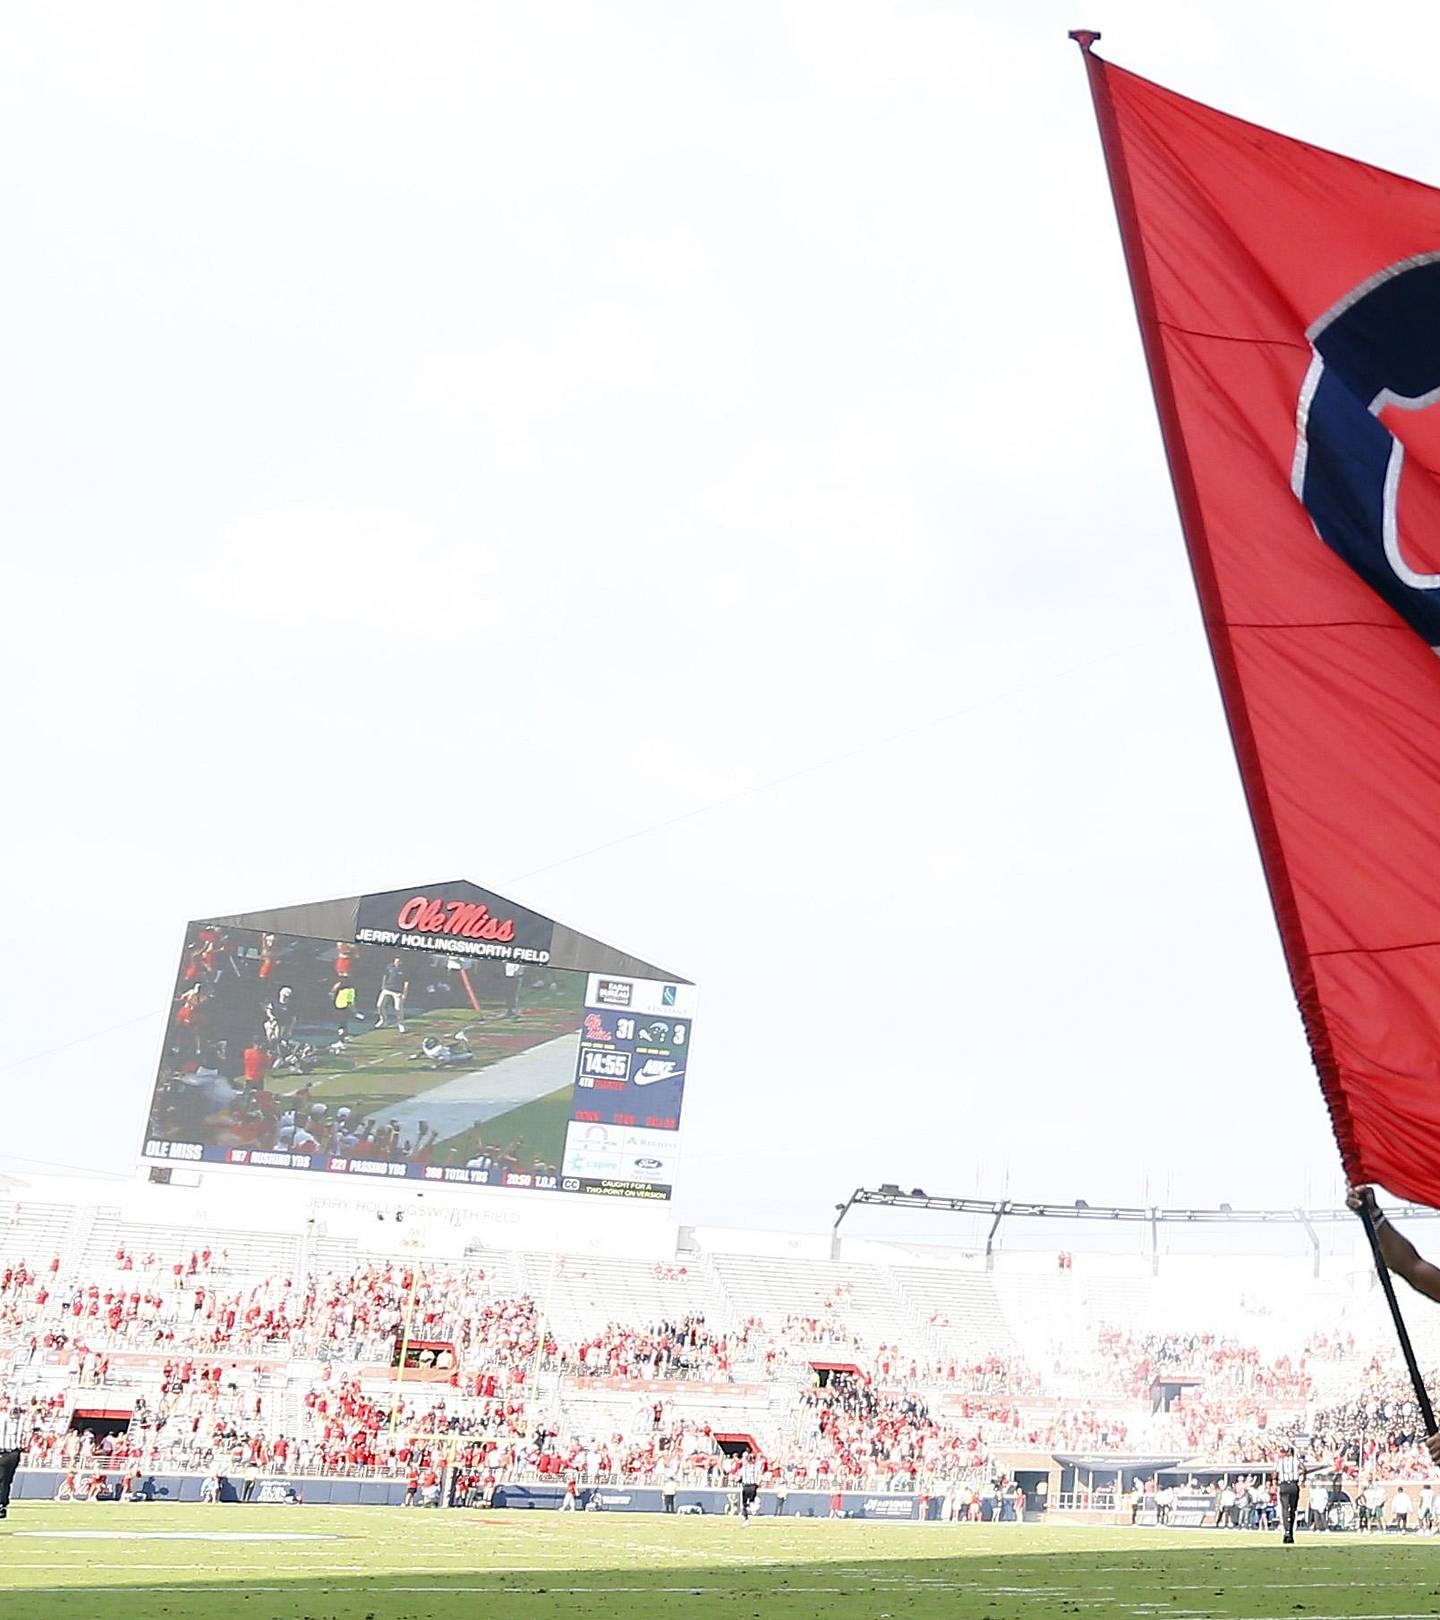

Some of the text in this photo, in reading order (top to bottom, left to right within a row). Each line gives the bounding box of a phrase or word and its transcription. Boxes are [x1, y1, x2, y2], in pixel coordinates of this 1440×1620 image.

[397, 896, 516, 942] Ole Miss
[355, 929, 550, 963] JERRY HOLLINGSWORTH FIELD
[616, 1018, 635, 1040] 31
[672, 1024, 686, 1045] 3
[585, 1052, 627, 1075] 14:55
[642, 1059, 676, 1074] NIKE
[146, 1140, 203, 1160] OLE MISS
[445, 1168, 470, 1181] TOTAL
[601, 1180, 630, 1189] CAUGHT
[630, 1182, 646, 1190] FOR
